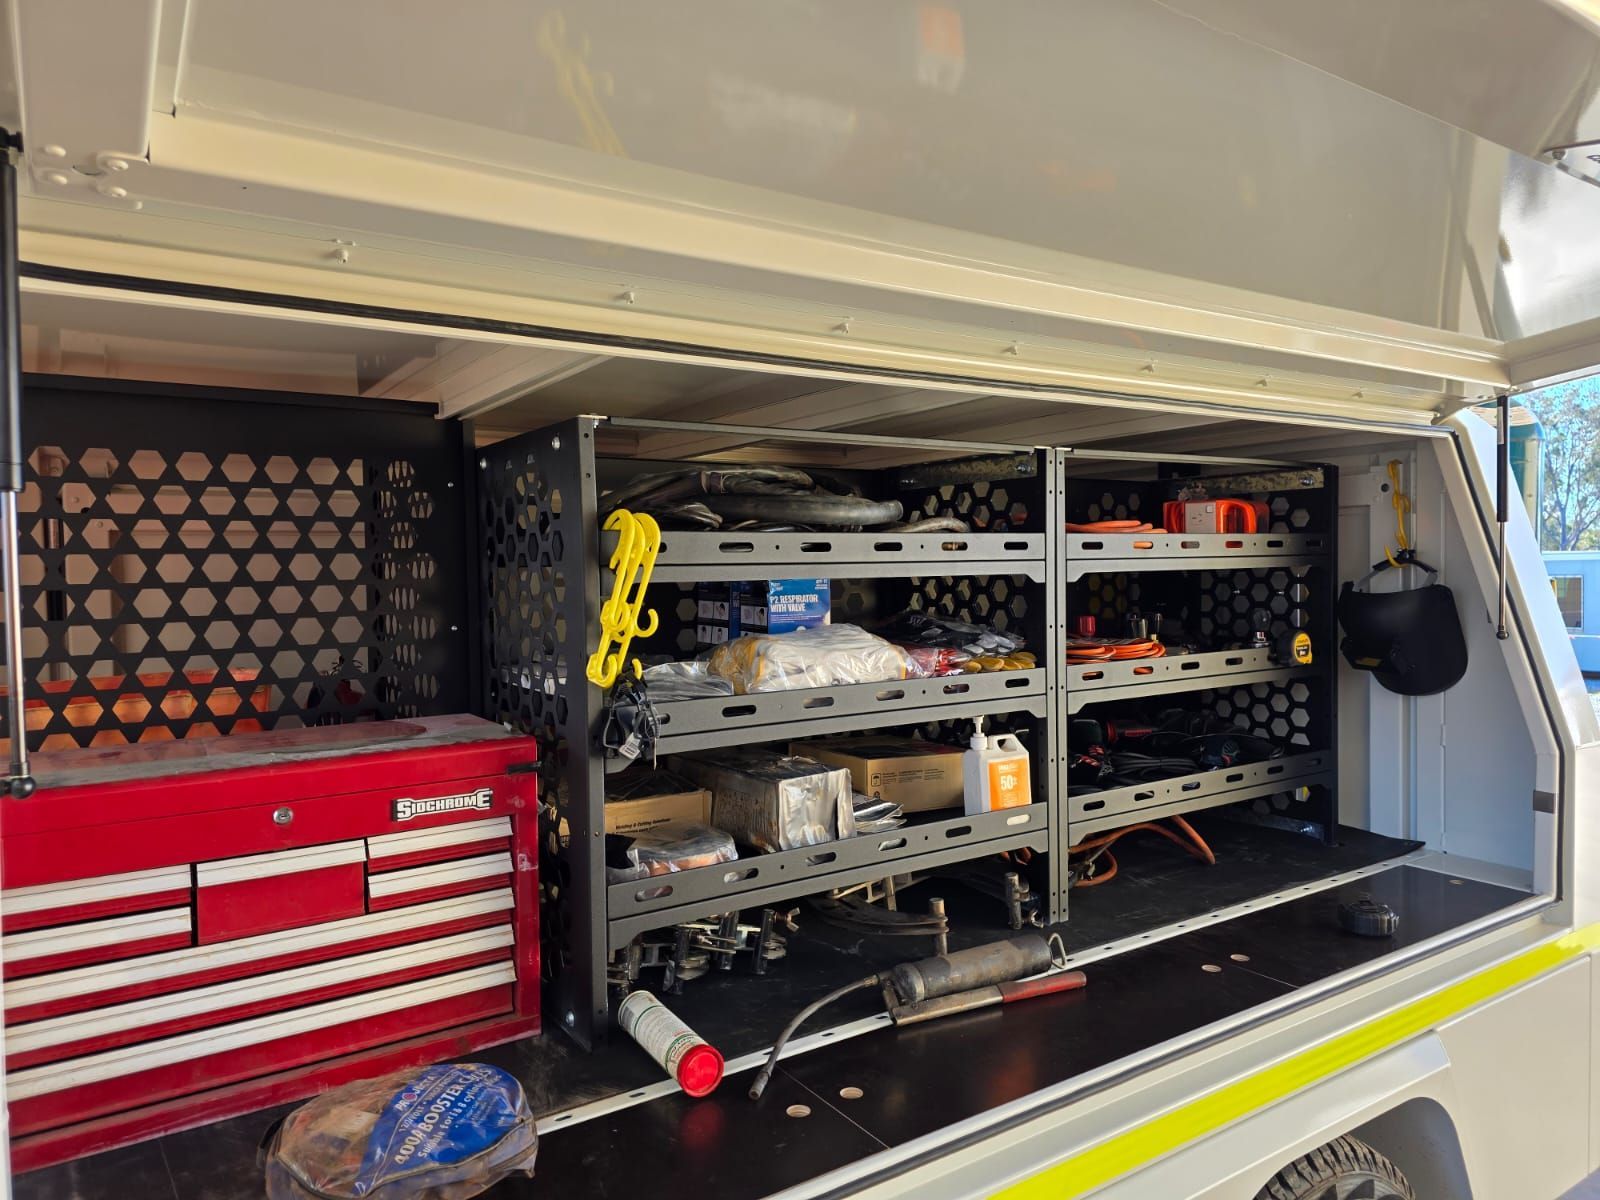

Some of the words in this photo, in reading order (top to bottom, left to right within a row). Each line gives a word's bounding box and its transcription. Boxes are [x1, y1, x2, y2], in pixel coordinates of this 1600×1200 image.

[769, 595, 779, 604] P2
[780, 594, 818, 604] RESPIRATOR
[770, 603, 787, 612] WITH
[788, 603, 806, 612] VALVE
[396, 790, 492, 819] SIDCHROME
[418, 1082, 466, 1132] BOOSTER
